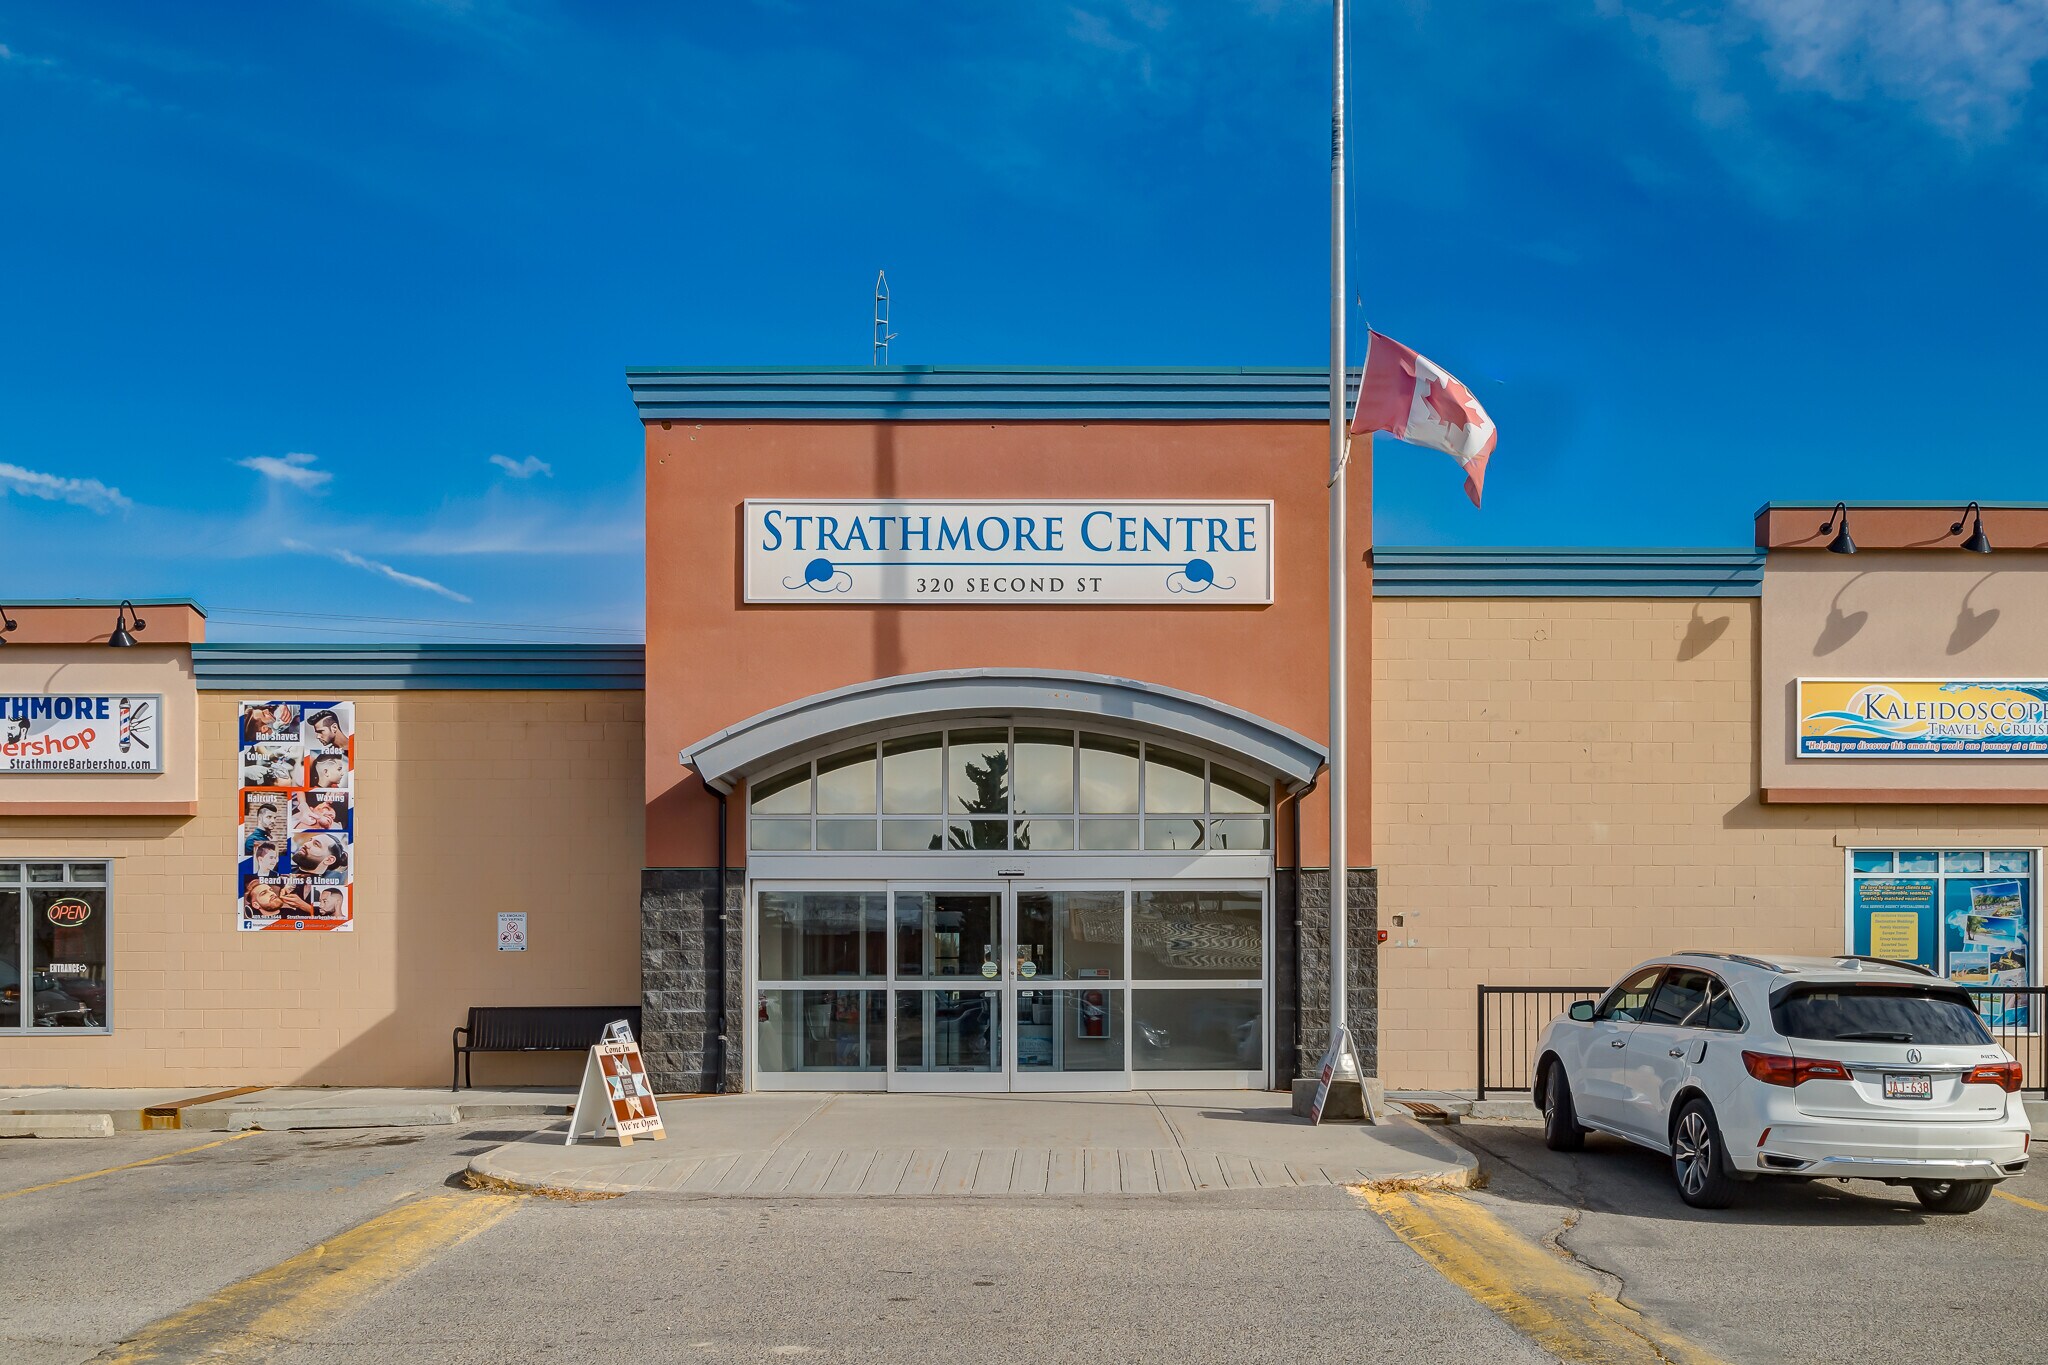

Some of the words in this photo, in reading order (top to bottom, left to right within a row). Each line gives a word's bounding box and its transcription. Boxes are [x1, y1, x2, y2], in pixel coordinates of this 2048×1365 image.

[762, 510, 1064, 552] STRATHMORE
[1080, 511, 1257, 552] CENTRE
[916, 577, 954, 593] 320
[966, 577, 1064, 593] SECOND
[1078, 577, 1102, 593] ST
[1928, 723, 1980, 734] TRAVEL
[1984, 723, 1996, 734] &
[0, 728, 96, 756] ershop
[1842, 742, 1856, 752] you
[1857, 740, 1890, 750] discover
[1891, 740, 1905, 750] this
[1907, 742, 1940, 752] amazing
[1942, 741, 1964, 750] world
[1981, 742, 2011, 752] journey
[10, 759, 150, 769] StrathmoreBarbershop.com
[248, 794, 277, 802] Haircuts
[316, 794, 344, 802] Waxing
[314, 877, 339, 886] Lineup
[50, 906, 86, 919] OPEN
[50, 964, 80, 973] ENTRANCE
[1887, 1081, 1929, 1093] JAJ-638
[620, 1122, 640, 1131] We're
[641, 1118, 659, 1131] Open
